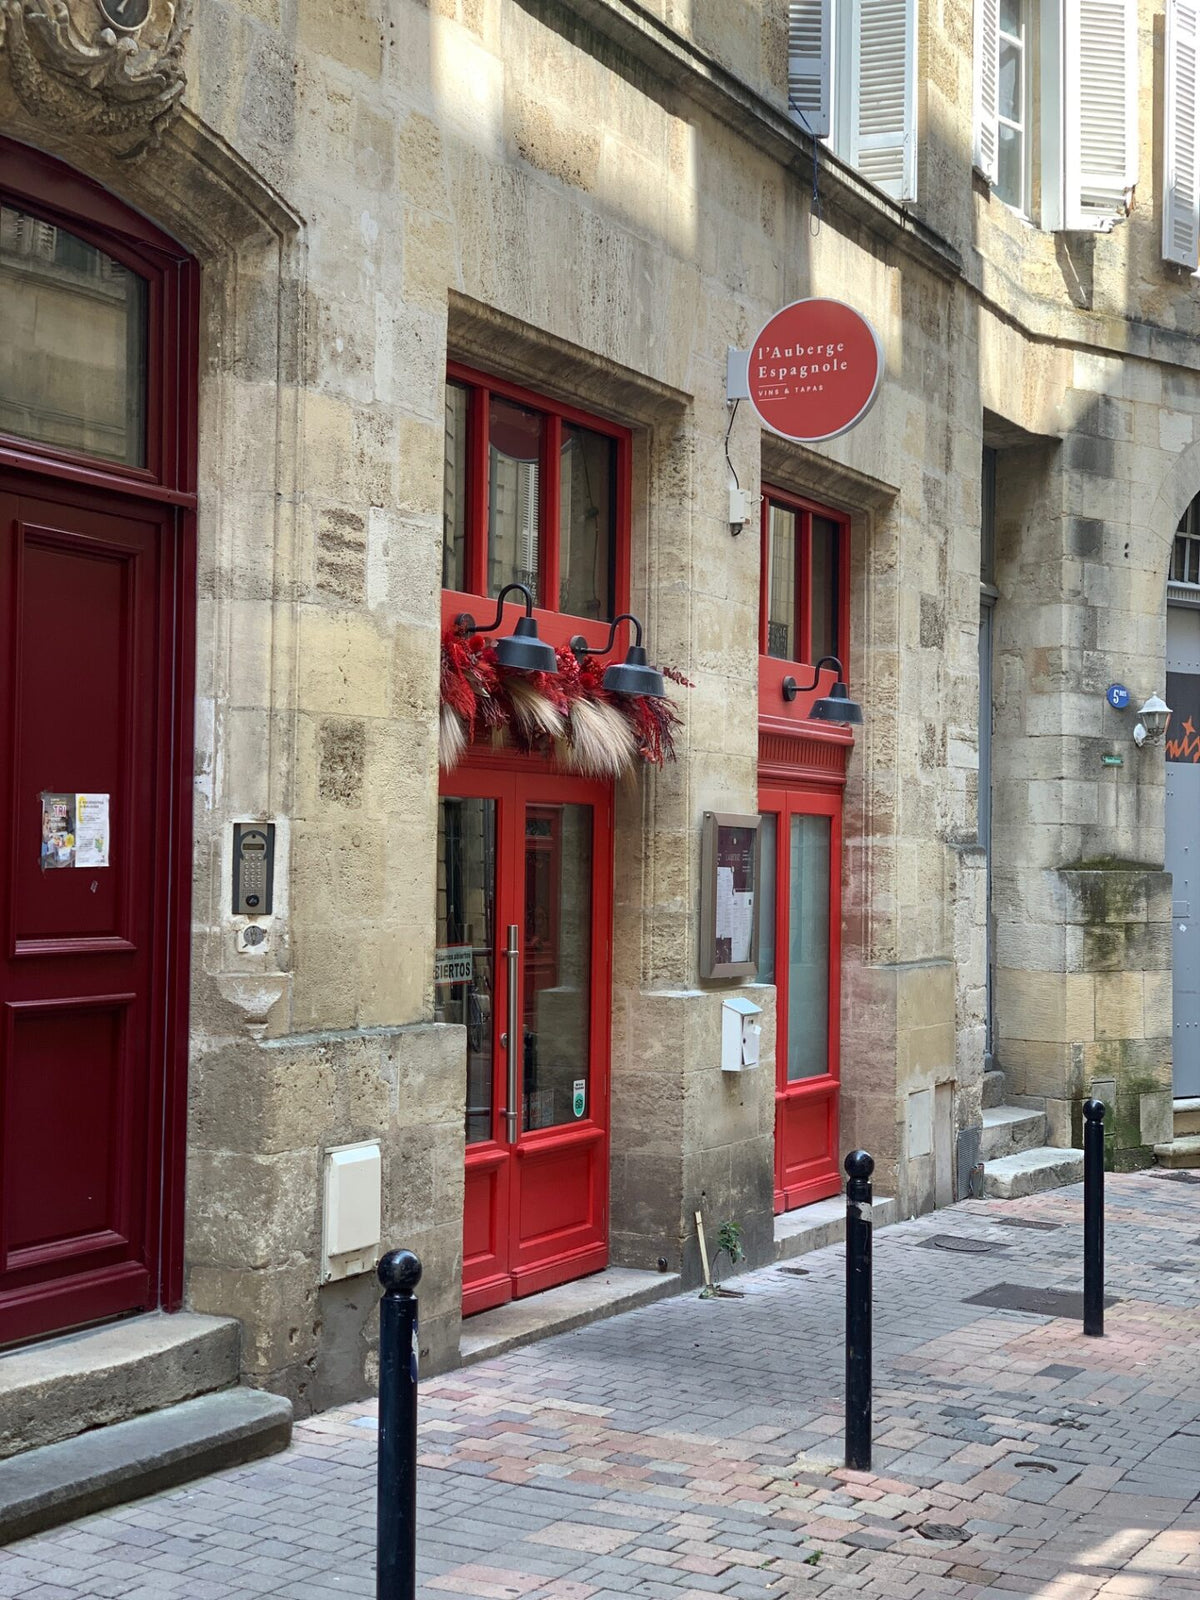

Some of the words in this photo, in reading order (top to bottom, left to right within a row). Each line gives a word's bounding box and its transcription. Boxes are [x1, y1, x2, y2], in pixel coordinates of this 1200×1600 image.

[758, 343, 844, 360] l'Auberge
[758, 359, 848, 380] Espagnole
[758, 388, 779, 397] VINS
[795, 384, 824, 393] TAPAS
[1113, 689, 1119, 704] 5
[433, 962, 471, 979] BIERTOS
